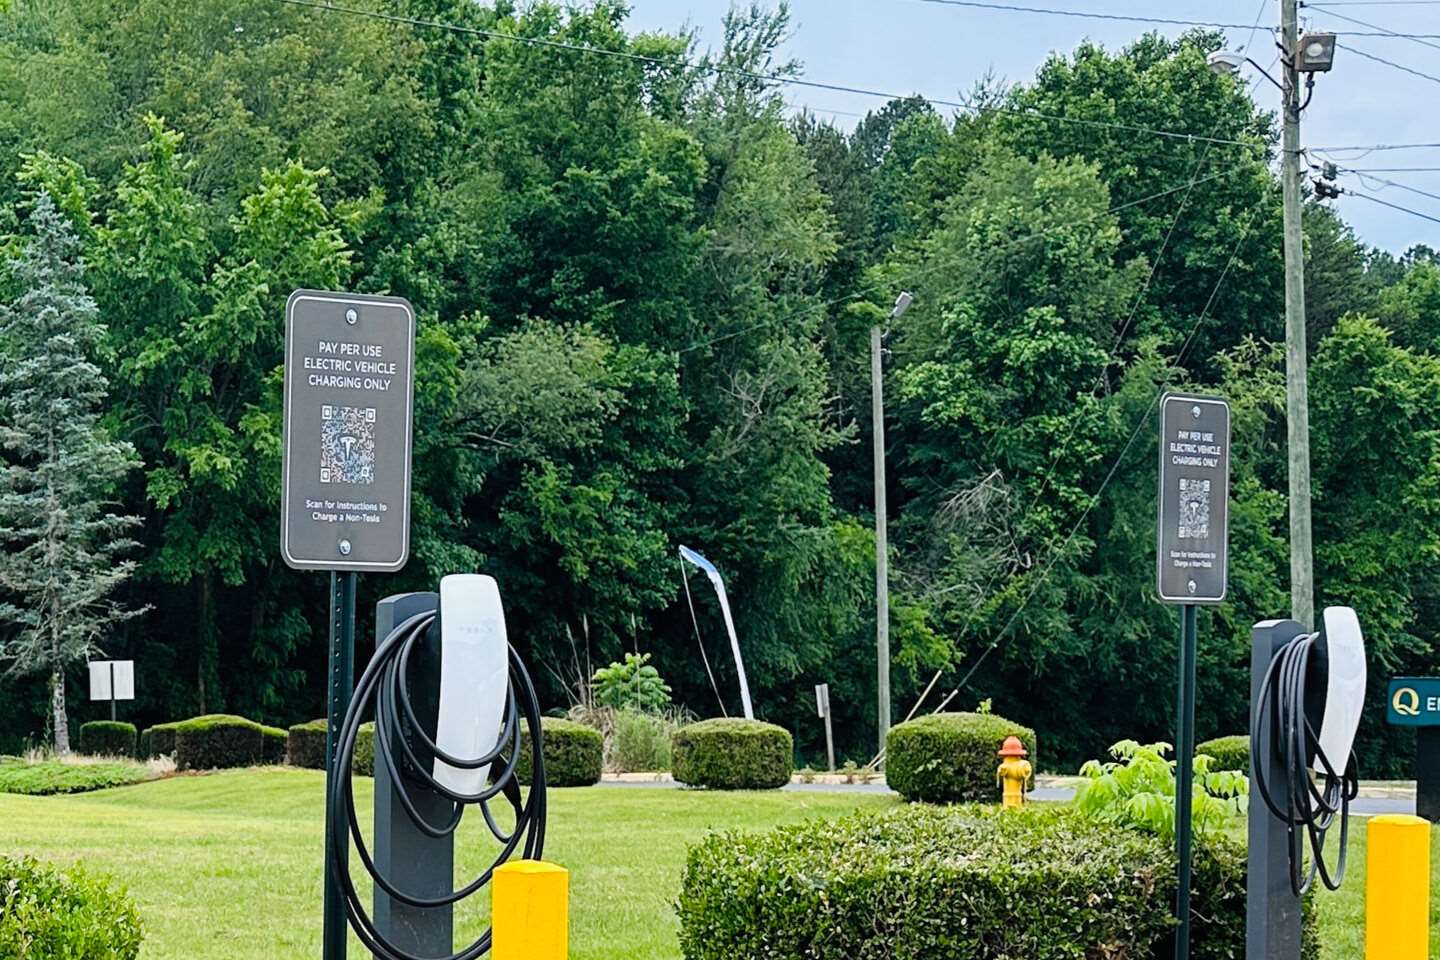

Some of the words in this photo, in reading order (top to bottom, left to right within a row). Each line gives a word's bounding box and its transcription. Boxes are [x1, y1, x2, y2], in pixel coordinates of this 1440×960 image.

[319, 341, 338, 354] PAY
[340, 343, 360, 355] PER
[362, 345, 382, 357] USE
[304, 357, 352, 372] ELECTRIC
[354, 361, 396, 375] VEHICLE
[308, 374, 361, 389] CHARGING
[363, 378, 391, 391] ONLY
[306, 500, 323, 509] Scan
[324, 500, 335, 509] for
